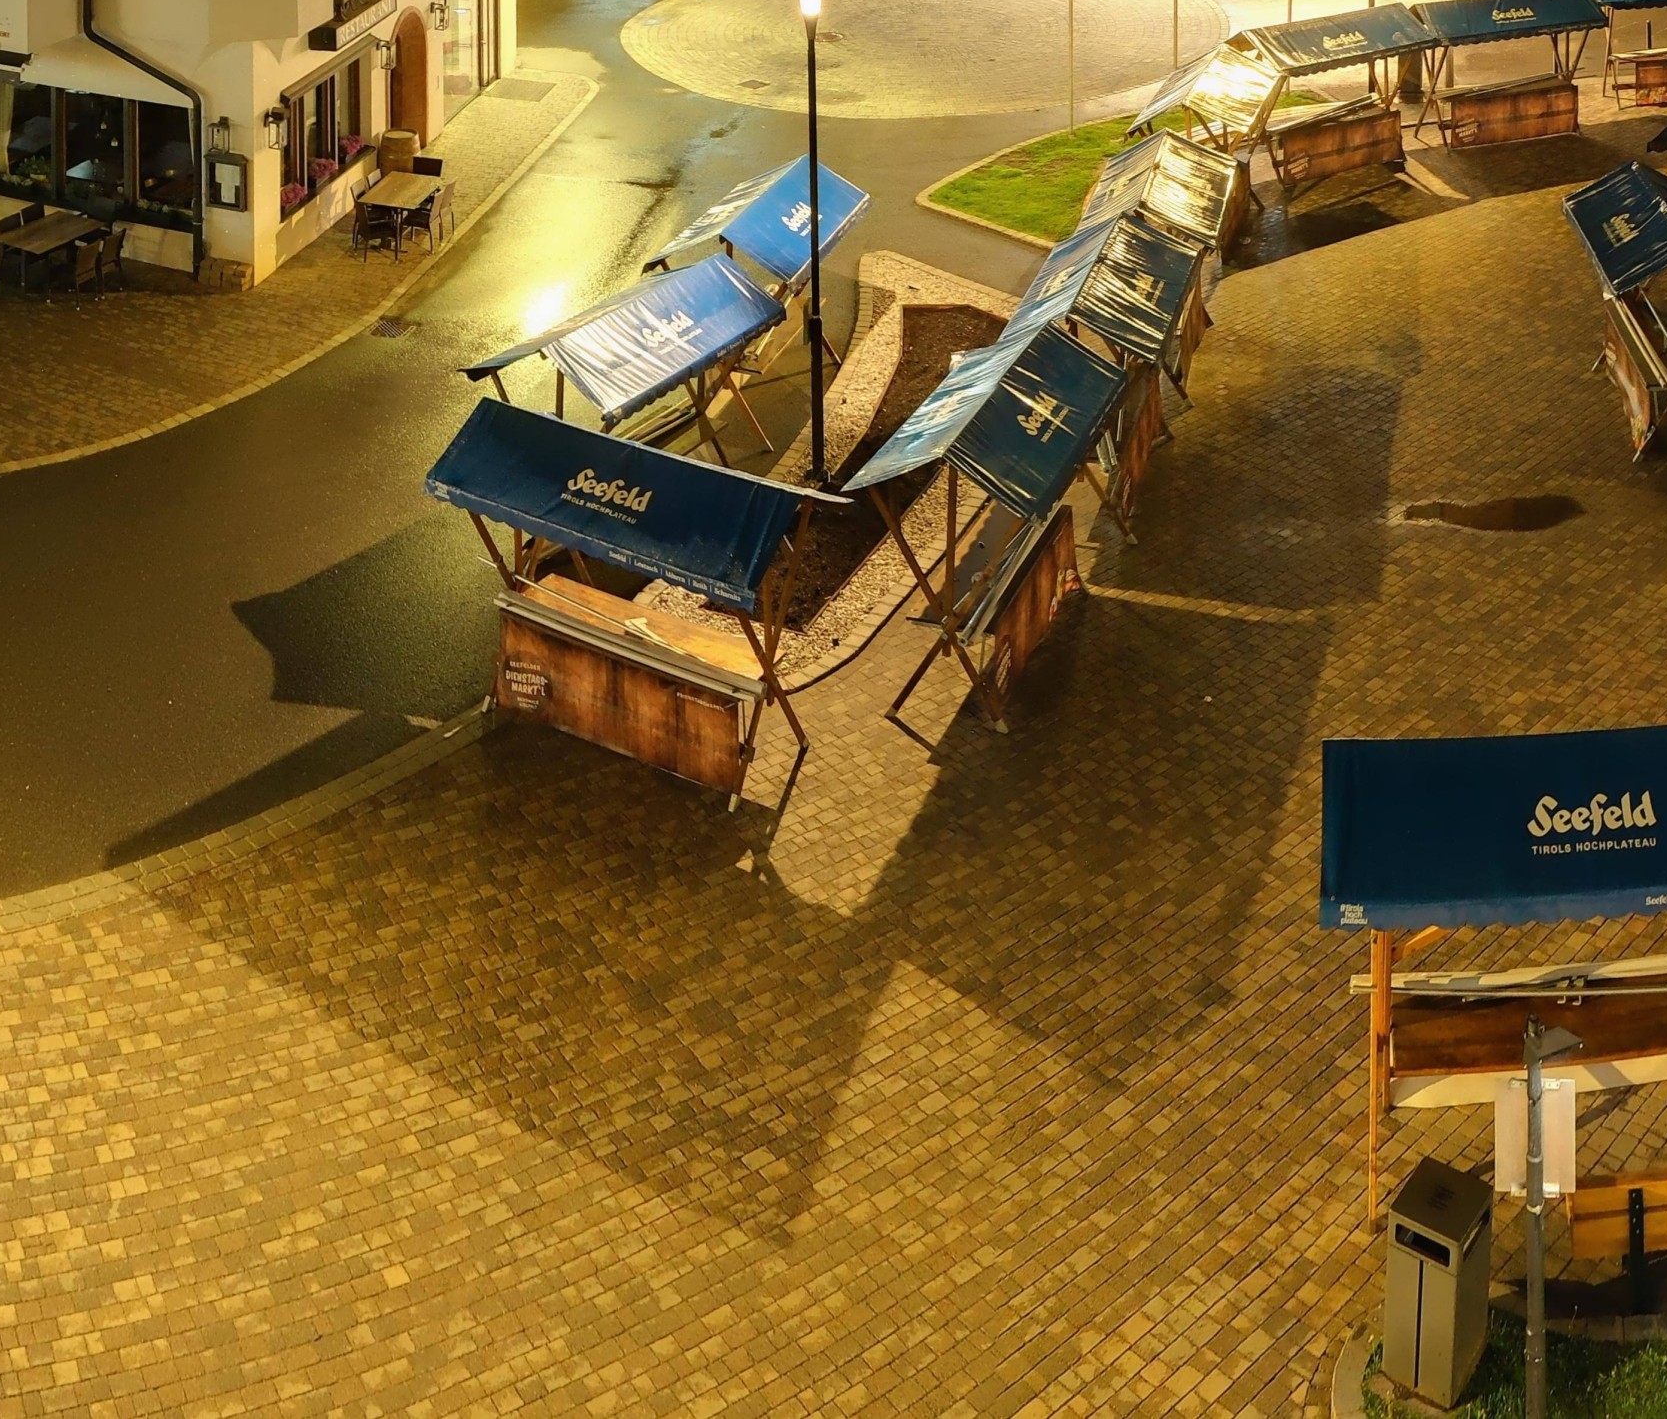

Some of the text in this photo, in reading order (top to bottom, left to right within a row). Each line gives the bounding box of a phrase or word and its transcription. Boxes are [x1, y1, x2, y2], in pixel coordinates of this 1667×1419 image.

[1492, 7, 1535, 20] Seefeld
[567, 468, 653, 512] Seefeld
[585, 501, 638, 525] HOCHPLATEAU
[1526, 790, 1657, 837] Seefeld
[1532, 837, 1657, 856] TIROLS HOCHPLATEAU
